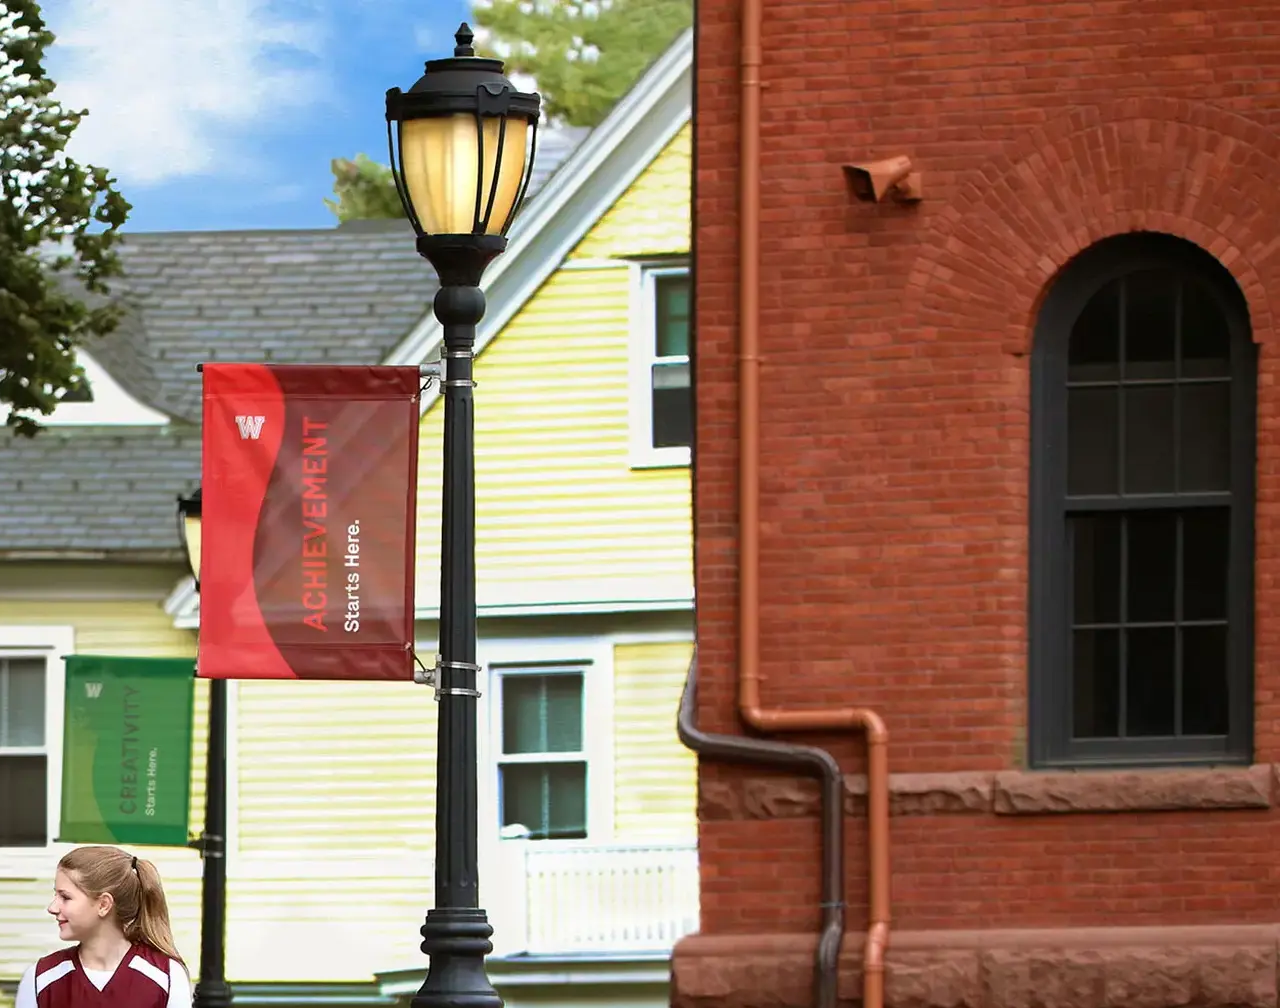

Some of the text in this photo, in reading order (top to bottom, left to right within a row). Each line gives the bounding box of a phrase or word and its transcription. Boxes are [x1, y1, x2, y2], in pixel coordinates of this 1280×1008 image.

[235, 415, 265, 440] W
[302, 416, 329, 632] ACHIEVEMENT
[344, 519, 360, 633] Starts Here.
[84, 682, 103, 699] W
[120, 684, 140, 815] CREATIVITY
[144, 747, 158, 816] Starts Here.
